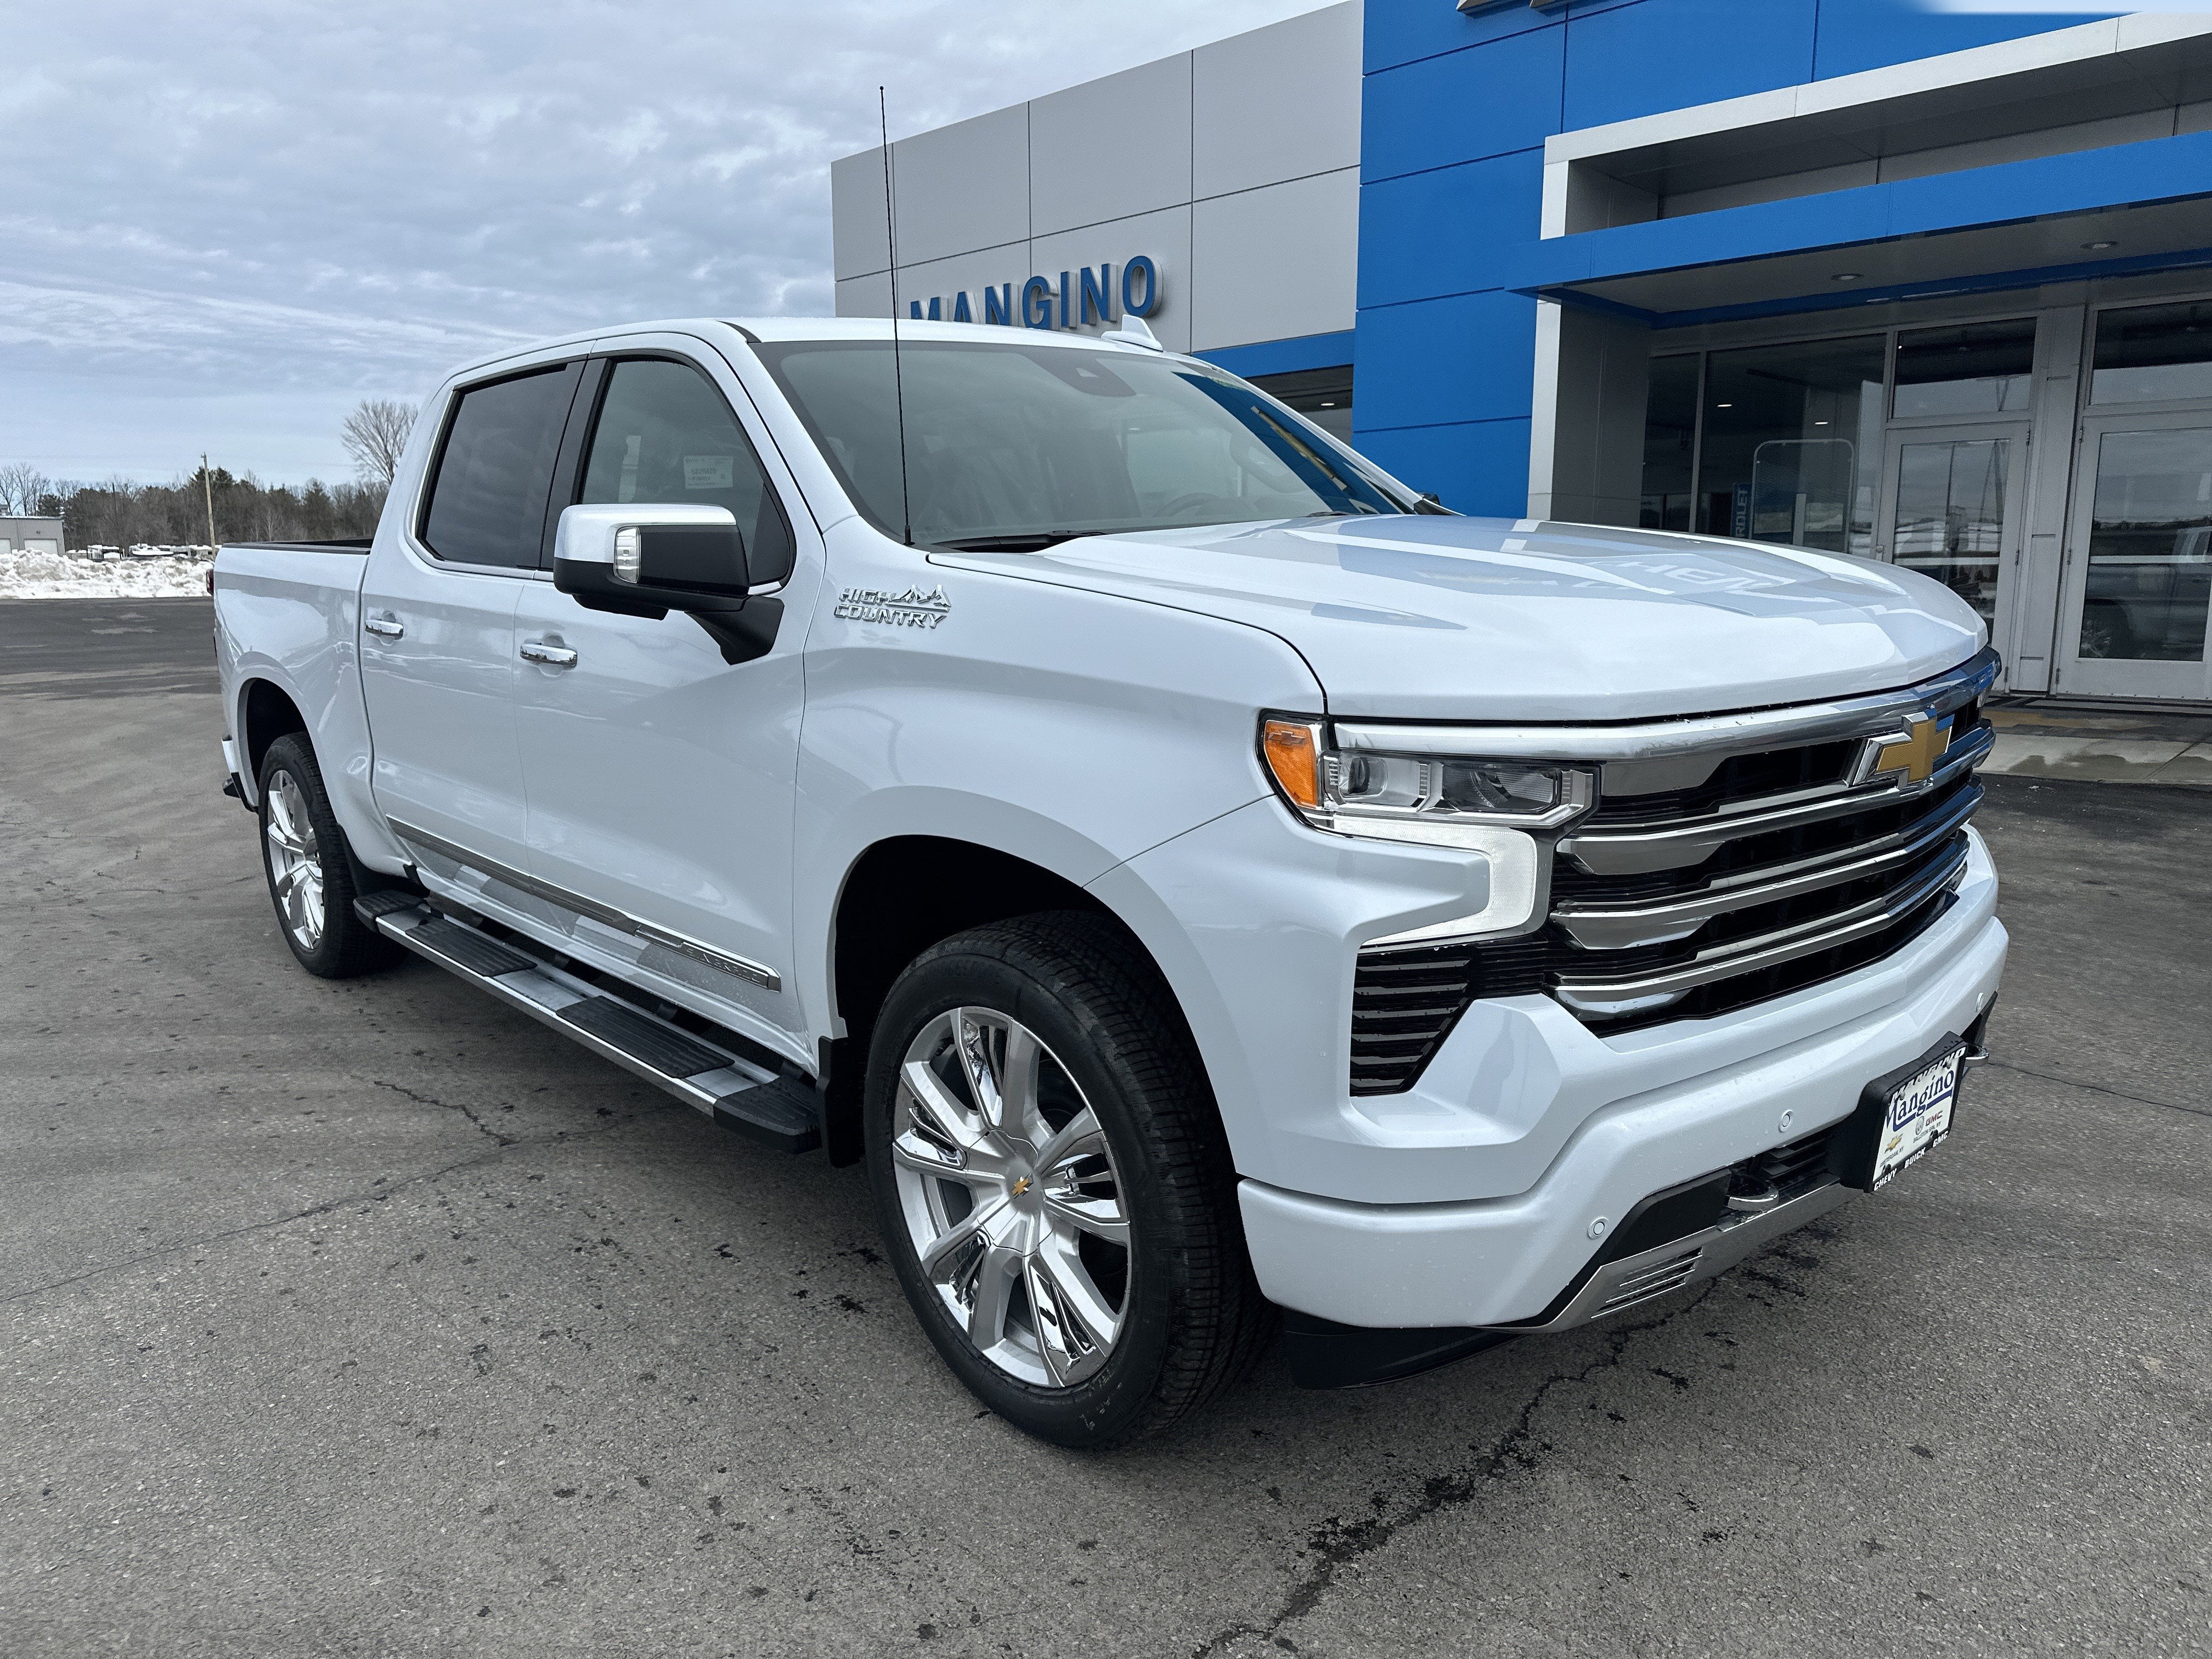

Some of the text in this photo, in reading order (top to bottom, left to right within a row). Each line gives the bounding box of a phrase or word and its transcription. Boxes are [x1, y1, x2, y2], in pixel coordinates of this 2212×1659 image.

[839, 587, 896, 605] HIGH
[833, 603, 947, 629] COUNTRY
[1886, 1070, 1954, 1132] Mangino
[1926, 1110, 1943, 1126] GMC
[1874, 1130, 1949, 1191] CHEVY BUICK GMC
